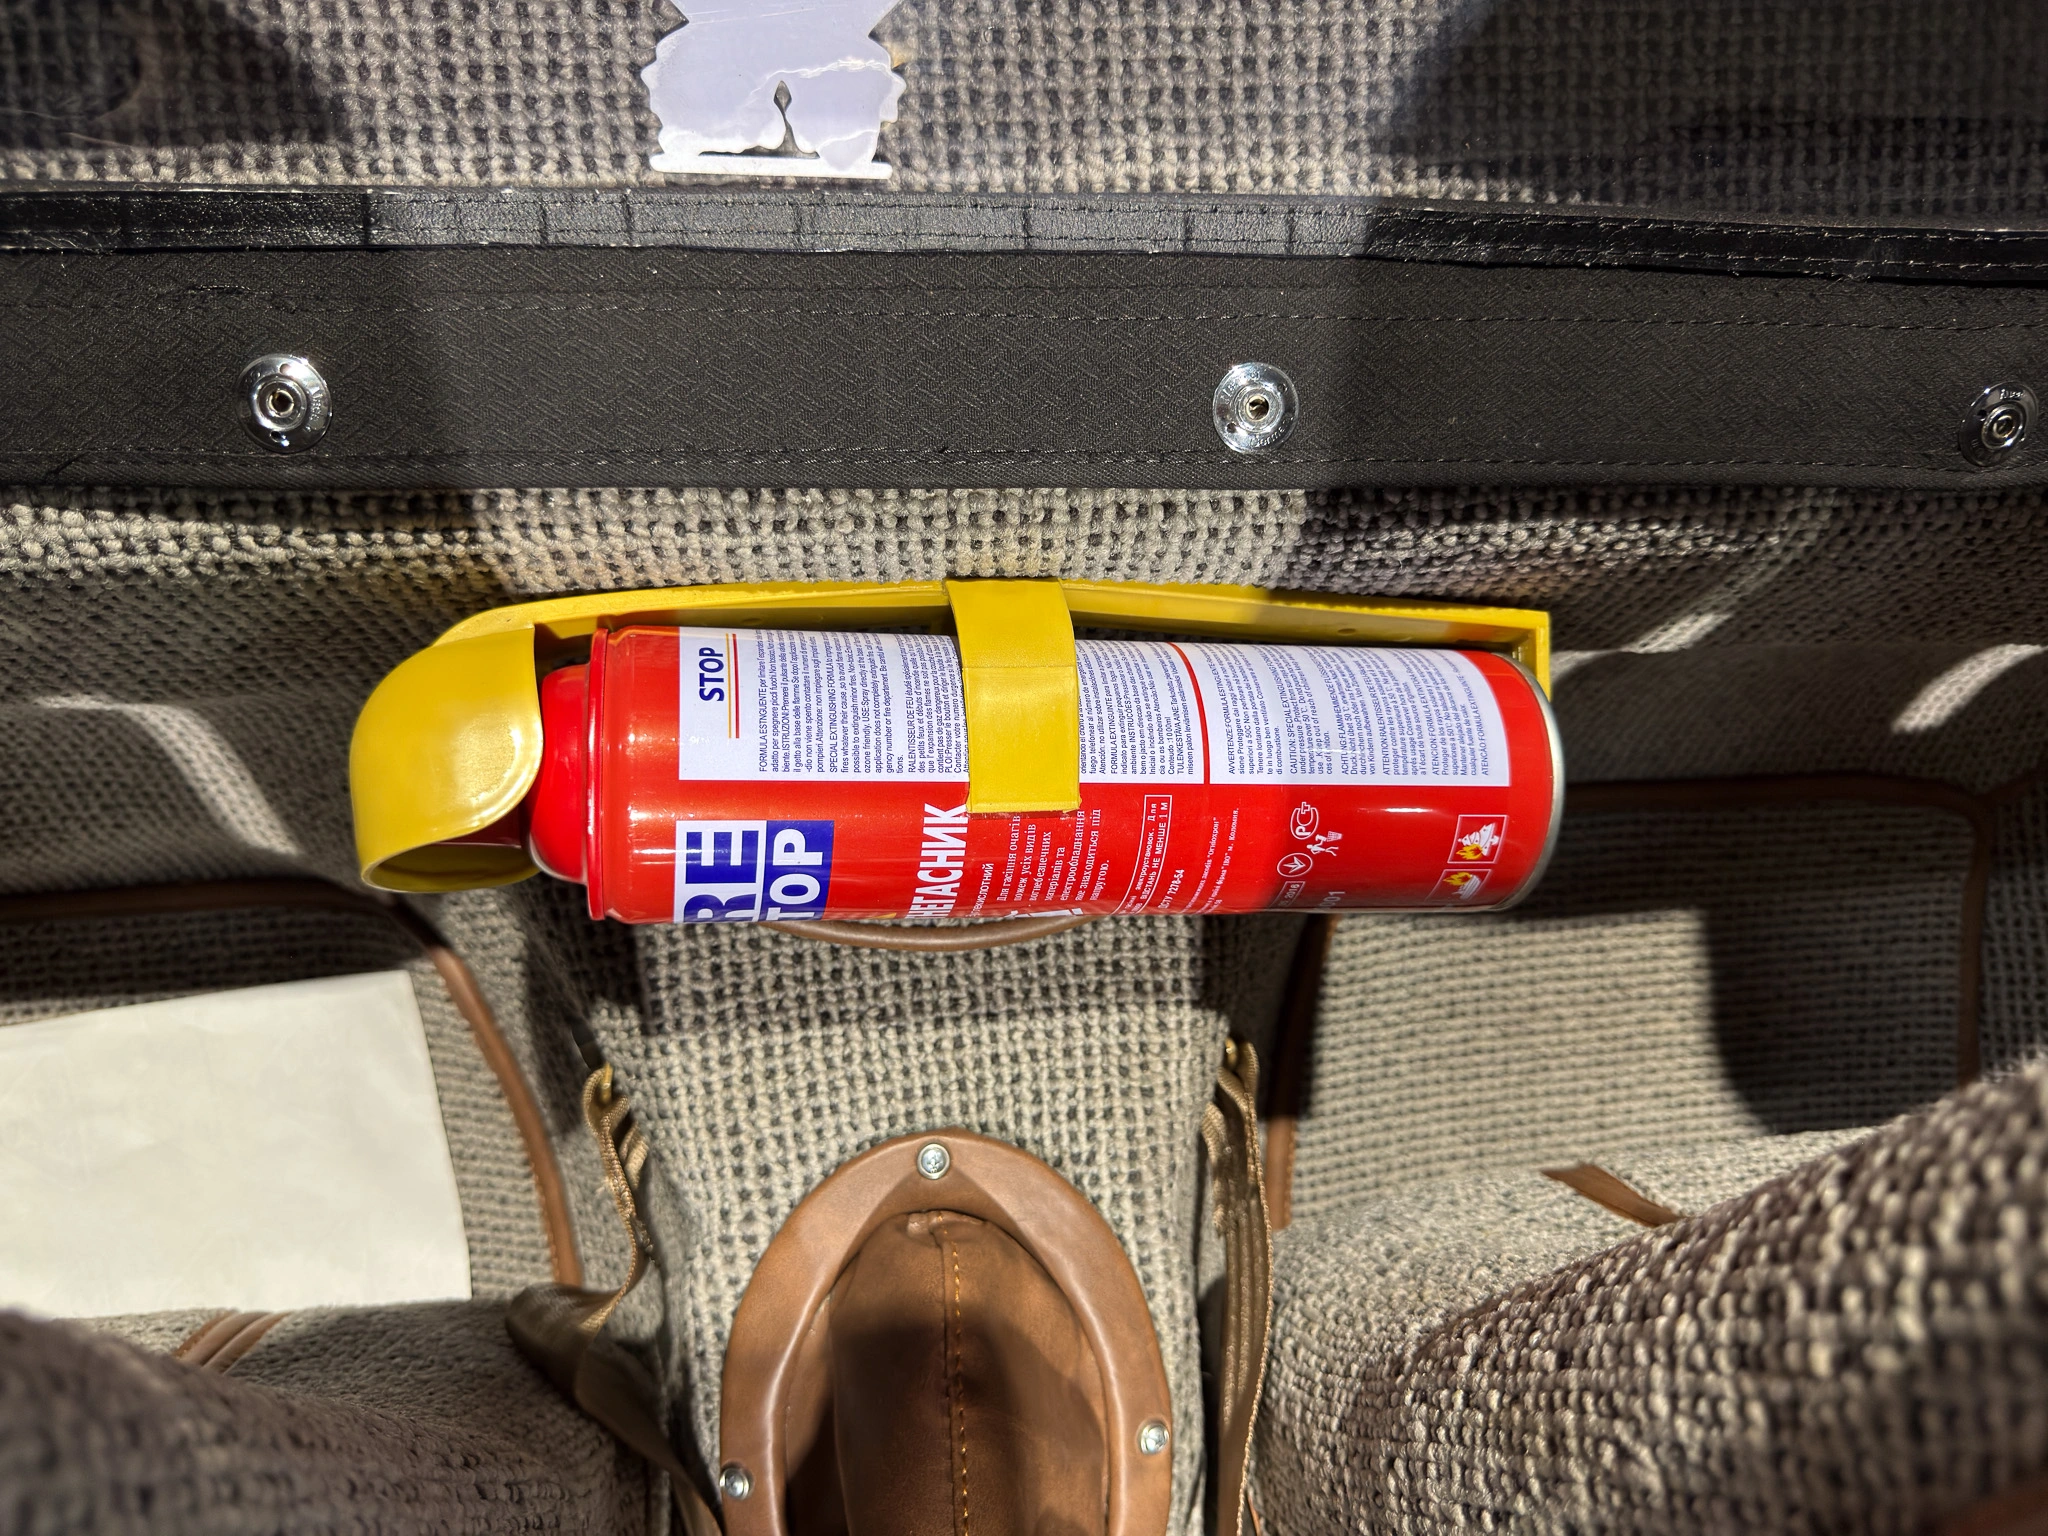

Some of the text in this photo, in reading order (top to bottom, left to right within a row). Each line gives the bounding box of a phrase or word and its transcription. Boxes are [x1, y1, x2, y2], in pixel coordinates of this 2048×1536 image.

[698, 648, 724, 701] STOP
[850, 687, 858, 702] minor
[870, 680, 881, 708] completely
[933, 686, 943, 714] dangereux
[1085, 694, 1093, 715] número
[1246, 691, 1257, 710] portata
[792, 706, 800, 719] delle
[804, 703, 813, 724] spento
[828, 689, 837, 740] EXTINGUISHING
[840, 711, 848, 724] their
[850, 704, 861, 735] extinguish
[883, 708, 891, 716] fire
[943, 701, 951, 720] bouton
[1094, 700, 1102, 714] sobre
[1243, 711, 1251, 723] Non
[1252, 711, 1260, 725] dalla
[1307, 699, 1317, 716] reach
[792, 721, 801, 736] base
[804, 726, 812, 743] viene
[906, 697, 916, 772] RALENTISSEUR DE FEU
[1096, 716, 1104, 734] utilizar
[1138, 729, 1144, 738] em
[1155, 714, 1164, 744] bombeiros
[1285, 709, 1294, 737] SPECIAL
[1402, 707, 1417, 756] usage Conserver
[771, 707, 780, 772] adatto per spegnere
[793, 737, 801, 749] alla
[841, 726, 849, 756] whatever
[862, 724, 872, 749] friendly.
[884, 726, 892, 751] number
[1088, 724, 1097, 754] telefonear
[1184, 733, 1193, 750] palon
[1235, 719, 1244, 754] Proteggere
[1254, 727, 1262, 750] lontano
[1273, 726, 1282, 767] combustione.
[1389, 727, 1397, 746] contre
[1417, 740, 1424, 748] de
[1456, 723, 1467, 775] Mantener alejado
[1466, 728, 1474, 746] fuente
[759, 735, 767, 771] FORMULA
[794, 750, 802, 767] getto
[852, 744, 861, 773] possible
[874, 738, 884, 773] application
[918, 741, 926, 758] petits
[936, 748, 944, 773] contient
[1098, 746, 1106, 774] Atención:
[1110, 740, 1118, 774] FORMULA
[1120, 735, 1128, 774] indicato para
[1159, 755, 1165, 763] ou
[1167, 745, 1175, 774] Conteudo
[1247, 745, 1255, 774] superiori
[1265, 741, 1273, 758] luogo
[1366, 738, 1374, 762] Kindern
[1392, 748, 1400, 775] proteger
[1398, 737, 1408, 775] température
[1441, 747, 1449, 775] Proteger
[1450, 743, 1458, 775] superiores
[1468, 747, 1478, 775] cualquier
[884, 753, 895, 773] gency
[896, 755, 904, 773] tions.
[928, 761, 936, 773] que
[1090, 756, 1098, 774] fuego
[1148, 804, 1156, 821] Для
[1079, 830, 1099, 888] знаходиться
[1090, 810, 1101, 826] під
[1155, 823, 1166, 854] МЕНШЕ
[904, 803, 968, 918] НЕГАСНИК
[997, 815, 1021, 901] Для гасіння очагів
[1014, 824, 1036, 901] пожеж усіх видів
[1056, 847, 1065, 858] та
[1152, 858, 1160, 868] НЕ
